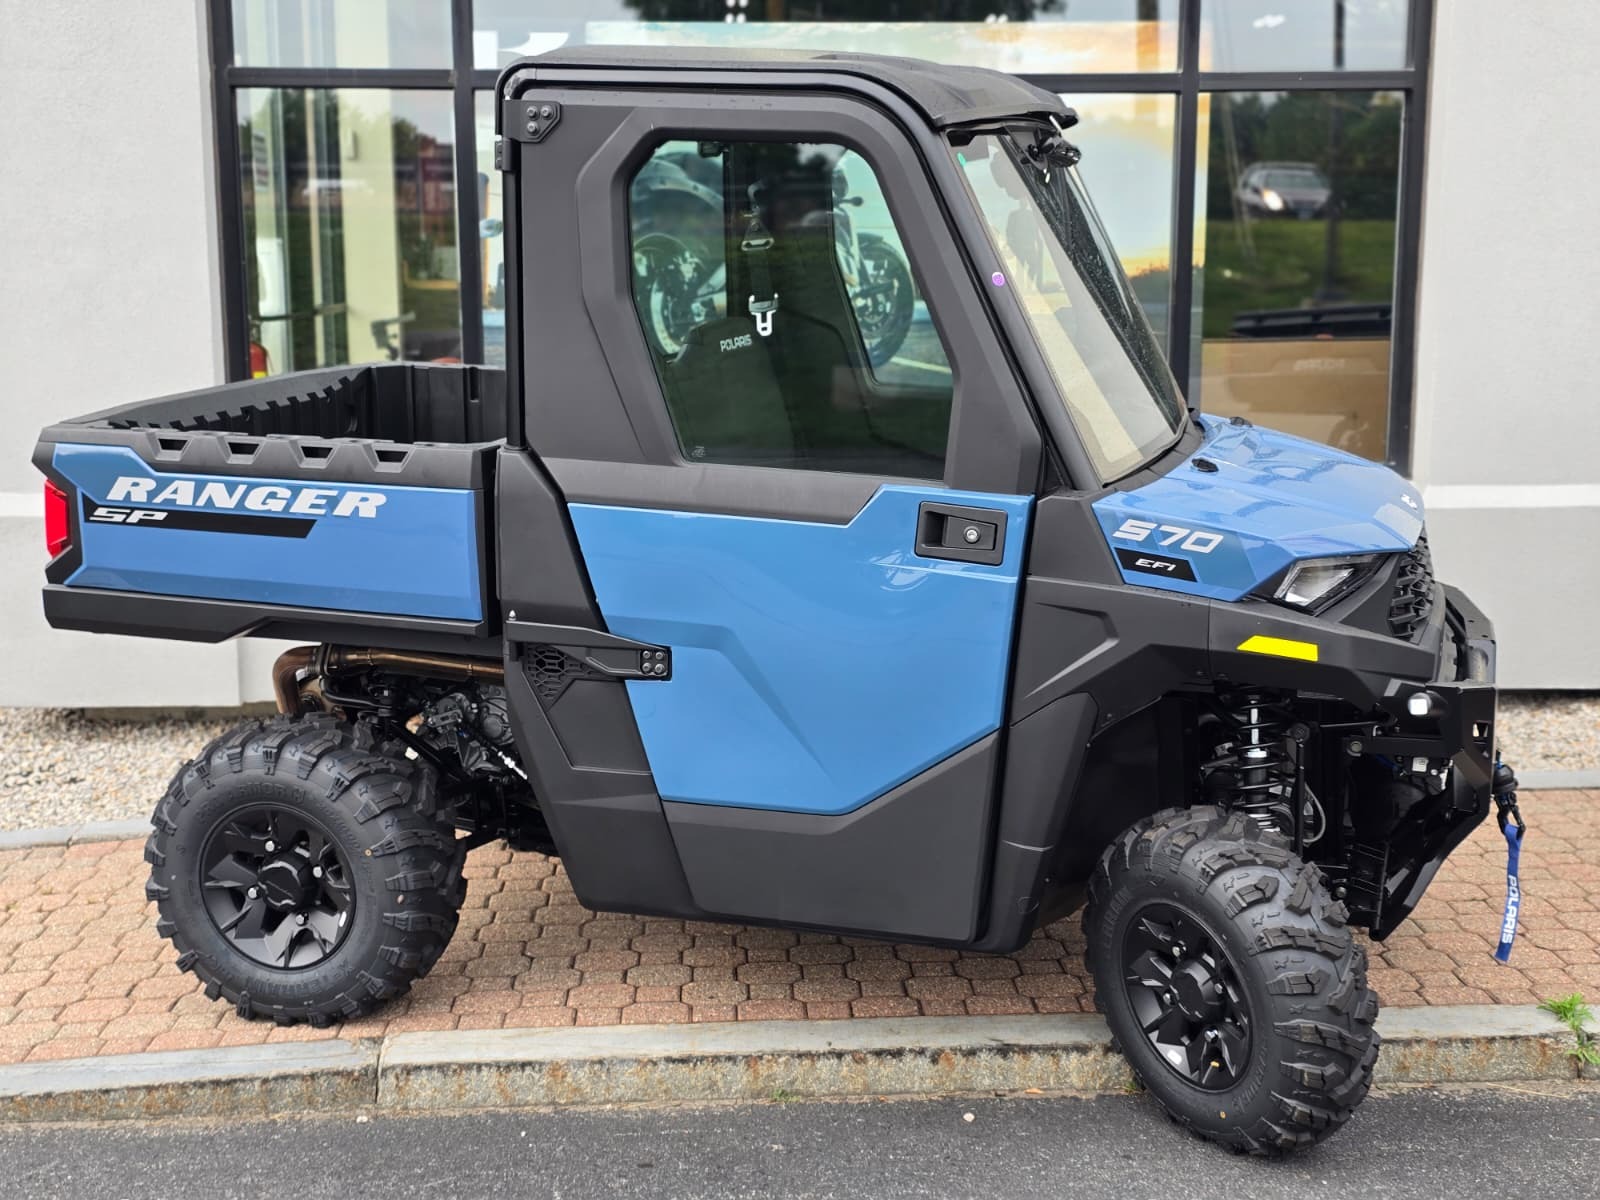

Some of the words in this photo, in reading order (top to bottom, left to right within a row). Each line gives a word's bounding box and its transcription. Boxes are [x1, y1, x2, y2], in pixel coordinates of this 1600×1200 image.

[720, 334, 752, 352] POLARIS
[106, 476, 387, 518] RANGER
[88, 506, 168, 523] SP
[1112, 519, 1224, 553] 570
[1135, 558, 1176, 571] EFI
[1502, 874, 1519, 943] POLARIS
